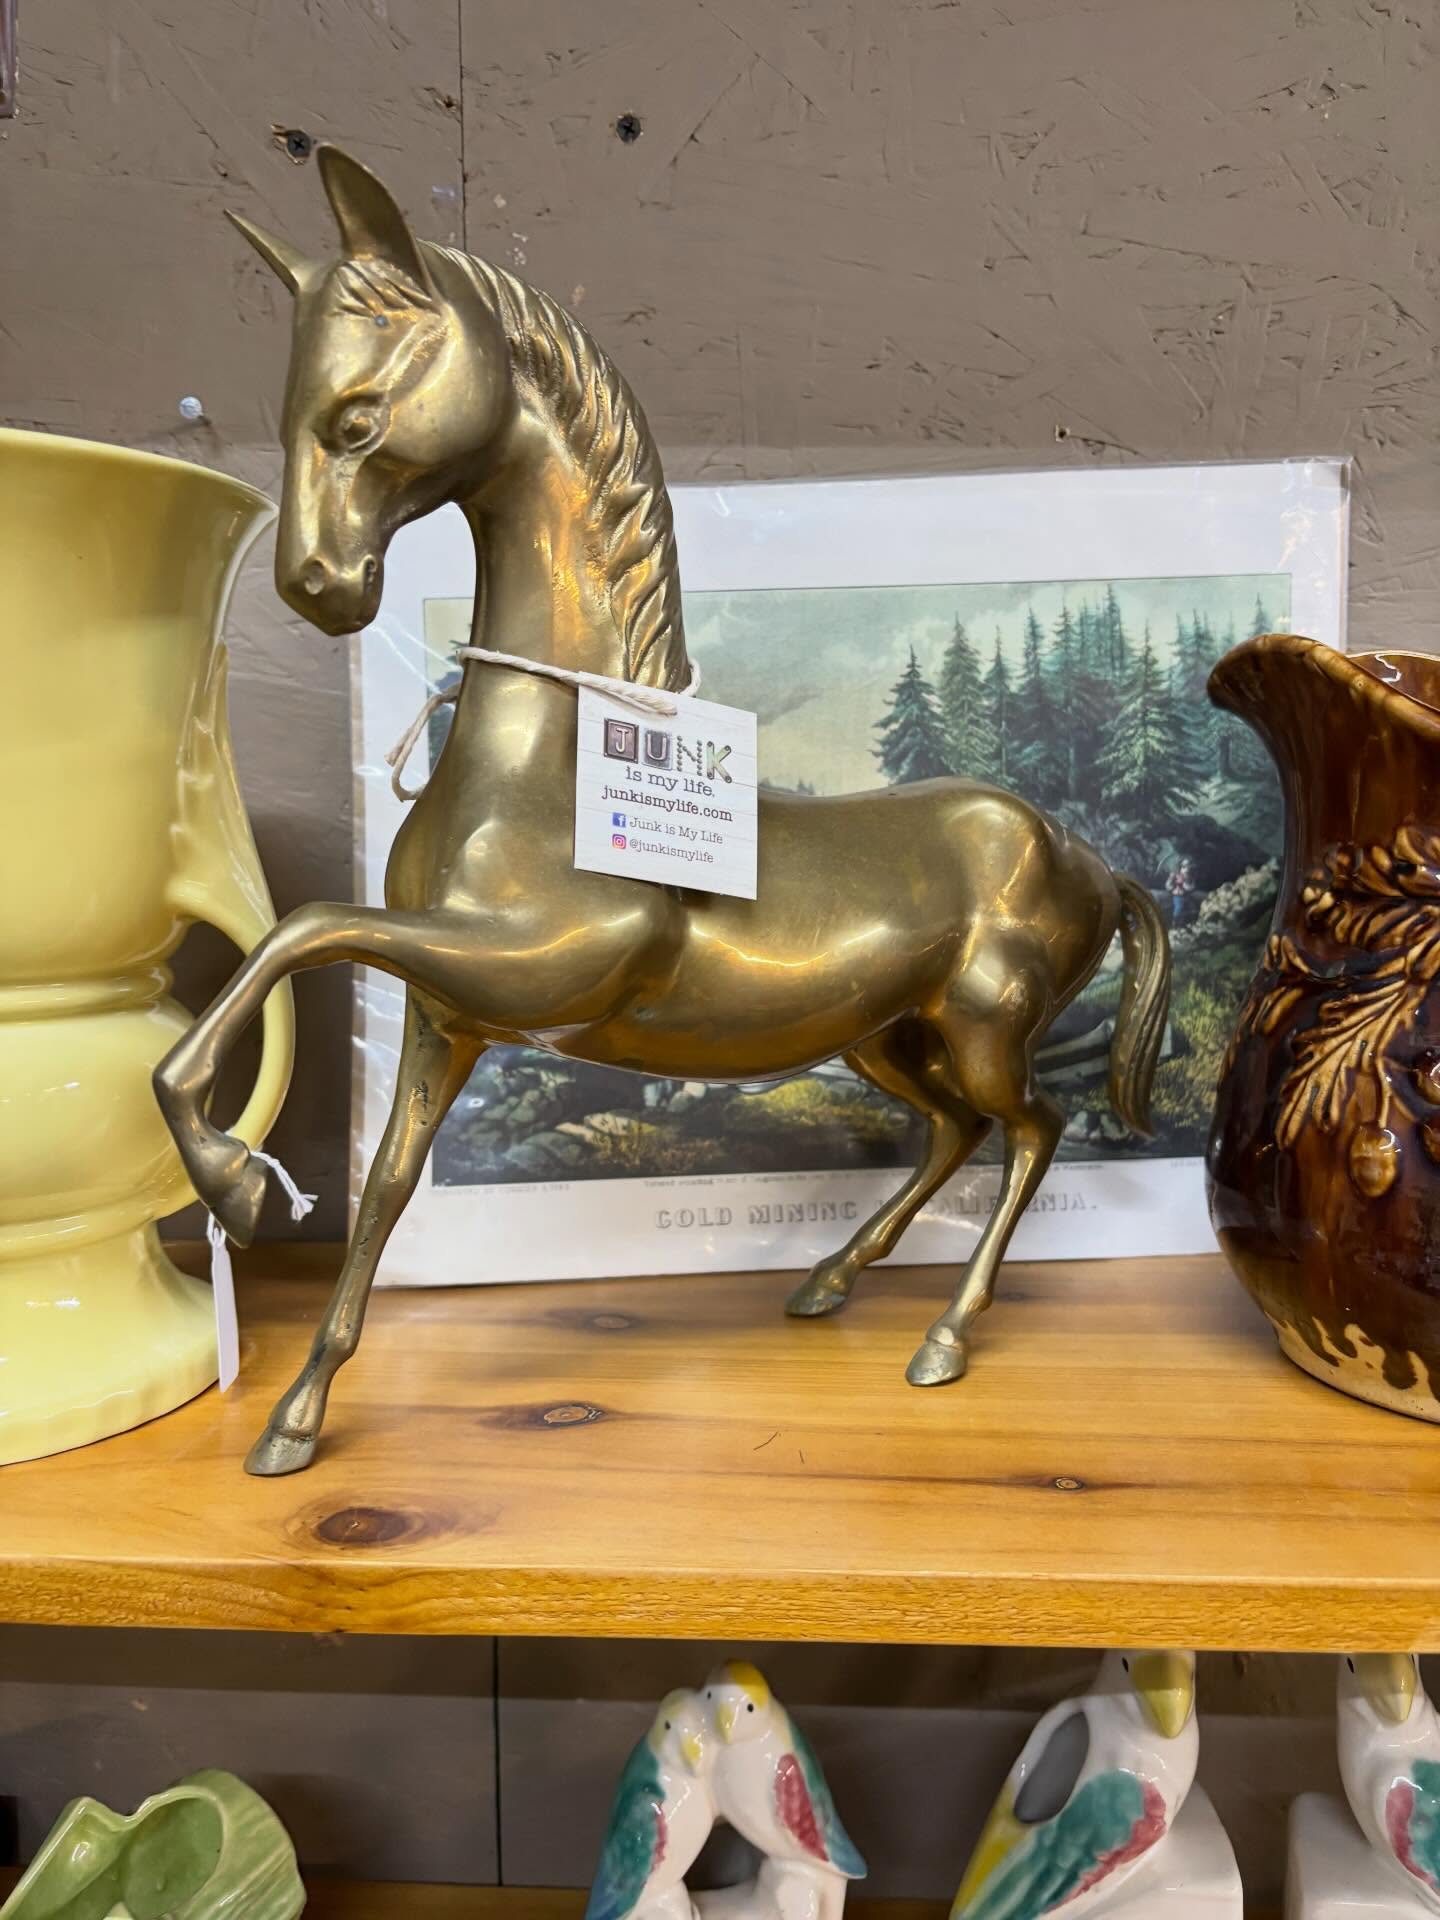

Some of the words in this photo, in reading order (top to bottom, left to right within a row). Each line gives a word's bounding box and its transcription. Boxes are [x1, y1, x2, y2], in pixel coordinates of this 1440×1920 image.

[604, 719, 732, 784] JUNK
[625, 765, 642, 782] is
[647, 773, 678, 791] my
[683, 777, 715, 797] life.
[601, 785, 733, 822] junkismylife.com
[629, 817, 662, 833] Junk
[665, 821, 676, 836] is
[679, 825, 699, 842] My
[701, 828, 723, 845] Life
[629, 837, 714, 864] @junkismylife
[655, 1207, 732, 1230] GOLD
[747, 1200, 858, 1225] MINING
